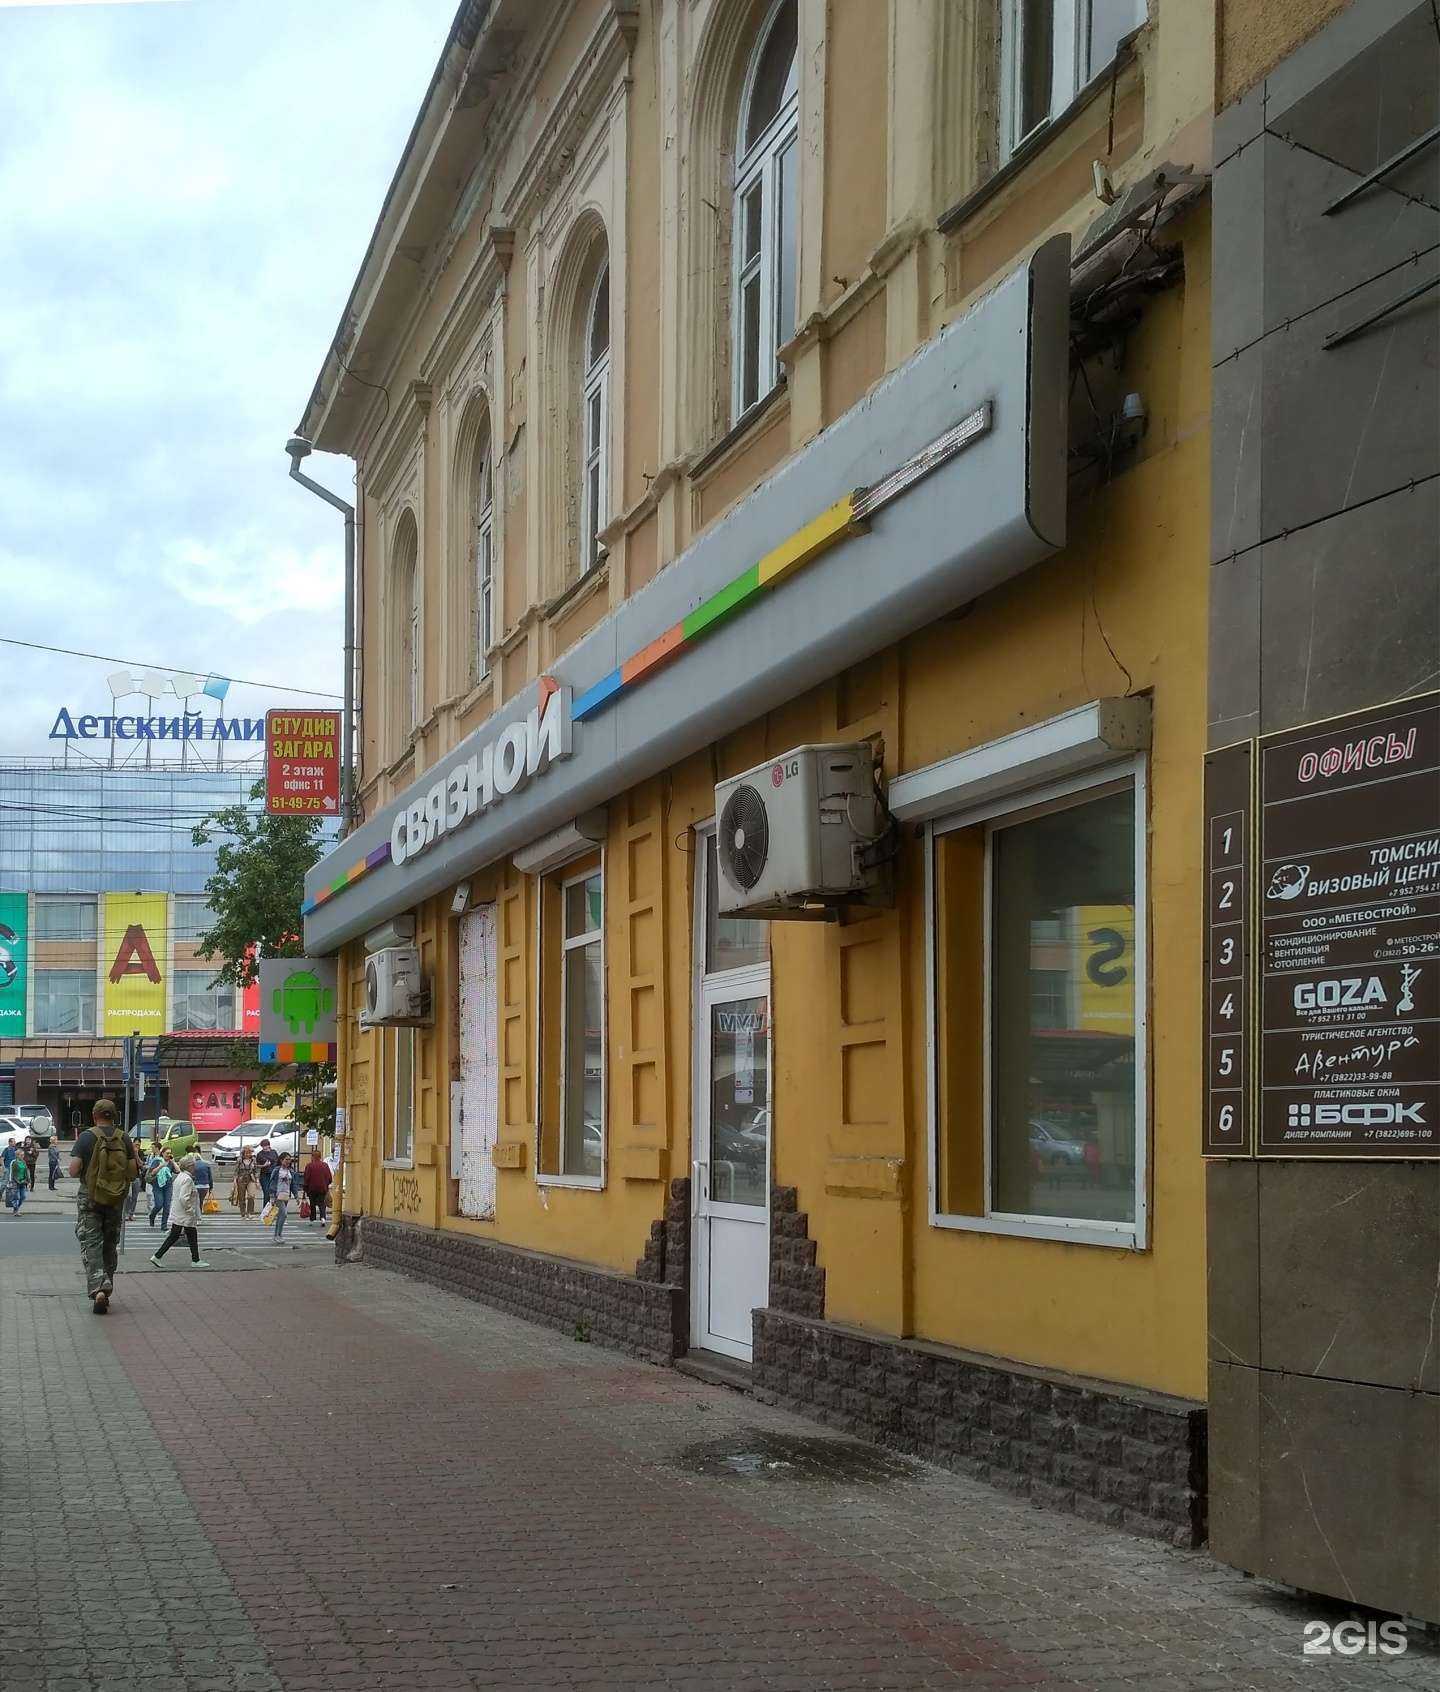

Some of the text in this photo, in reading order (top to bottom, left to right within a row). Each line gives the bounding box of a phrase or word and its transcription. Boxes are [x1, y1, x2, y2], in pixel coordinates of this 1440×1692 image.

[49, 707, 265, 741] Детский ми
[271, 717, 336, 736] СТУДИЯ
[272, 740, 335, 759] ЗАГАРА
[1298, 728, 1417, 782] ОФИСЫ
[282, 764, 325, 778] 2 этаж
[391, 676, 573, 865] СВЯЗНОЙ
[785, 761, 799, 779] LG
[284, 779, 324, 792] офис 11
[272, 796, 322, 810] 51-49-75
[1223, 828, 1233, 854] 1
[1369, 838, 1440, 866] ТОМСКИ
[1307, 867, 1391, 897] ВИЗОВЫЙ
[1399, 887, 1413, 896] 952
[1219, 882, 1234, 909] 2
[1302, 904, 1417, 928] ООО «МЕТЕОСТРОЙ»
[1274, 927, 1377, 948] КОНДИЦИОНИРОВАНИЕ
[1219, 938, 1234, 965] 3
[1274, 945, 1330, 958] ВЕНТИЛЯЦИЯ
[1402, 942, 1440, 956] 50-26-
[1274, 956, 1326, 969] ОТОПЛЕНИЕ
[1293, 976, 1387, 1010] GOZA
[108, 1008, 162, 1018] РАСПРОДАЖА
[1219, 993, 1234, 1019] 4
[1309, 1008, 1321, 1016] для
[1317, 1015, 1330, 1023] 952
[1332, 1014, 1345, 1022] 151
[1356, 1012, 1366, 1020] 00
[1301, 1026, 1413, 1041] ТУРИСТИЧЕСКОЕ АГЕНТСТВО
[1219, 1049, 1234, 1075] 5
[1294, 1036, 1420, 1079] Авентура
[1319, 1074, 1329, 1082] +7
[1314, 1088, 1400, 1099] ПЛАСТИКОВЫЕ ОКНА
[1219, 1105, 1234, 1131] 6
[1315, 1102, 1427, 1126] БФК
[1284, 1130, 1352, 1139] ДИЛЕР КОМПАНИИ
